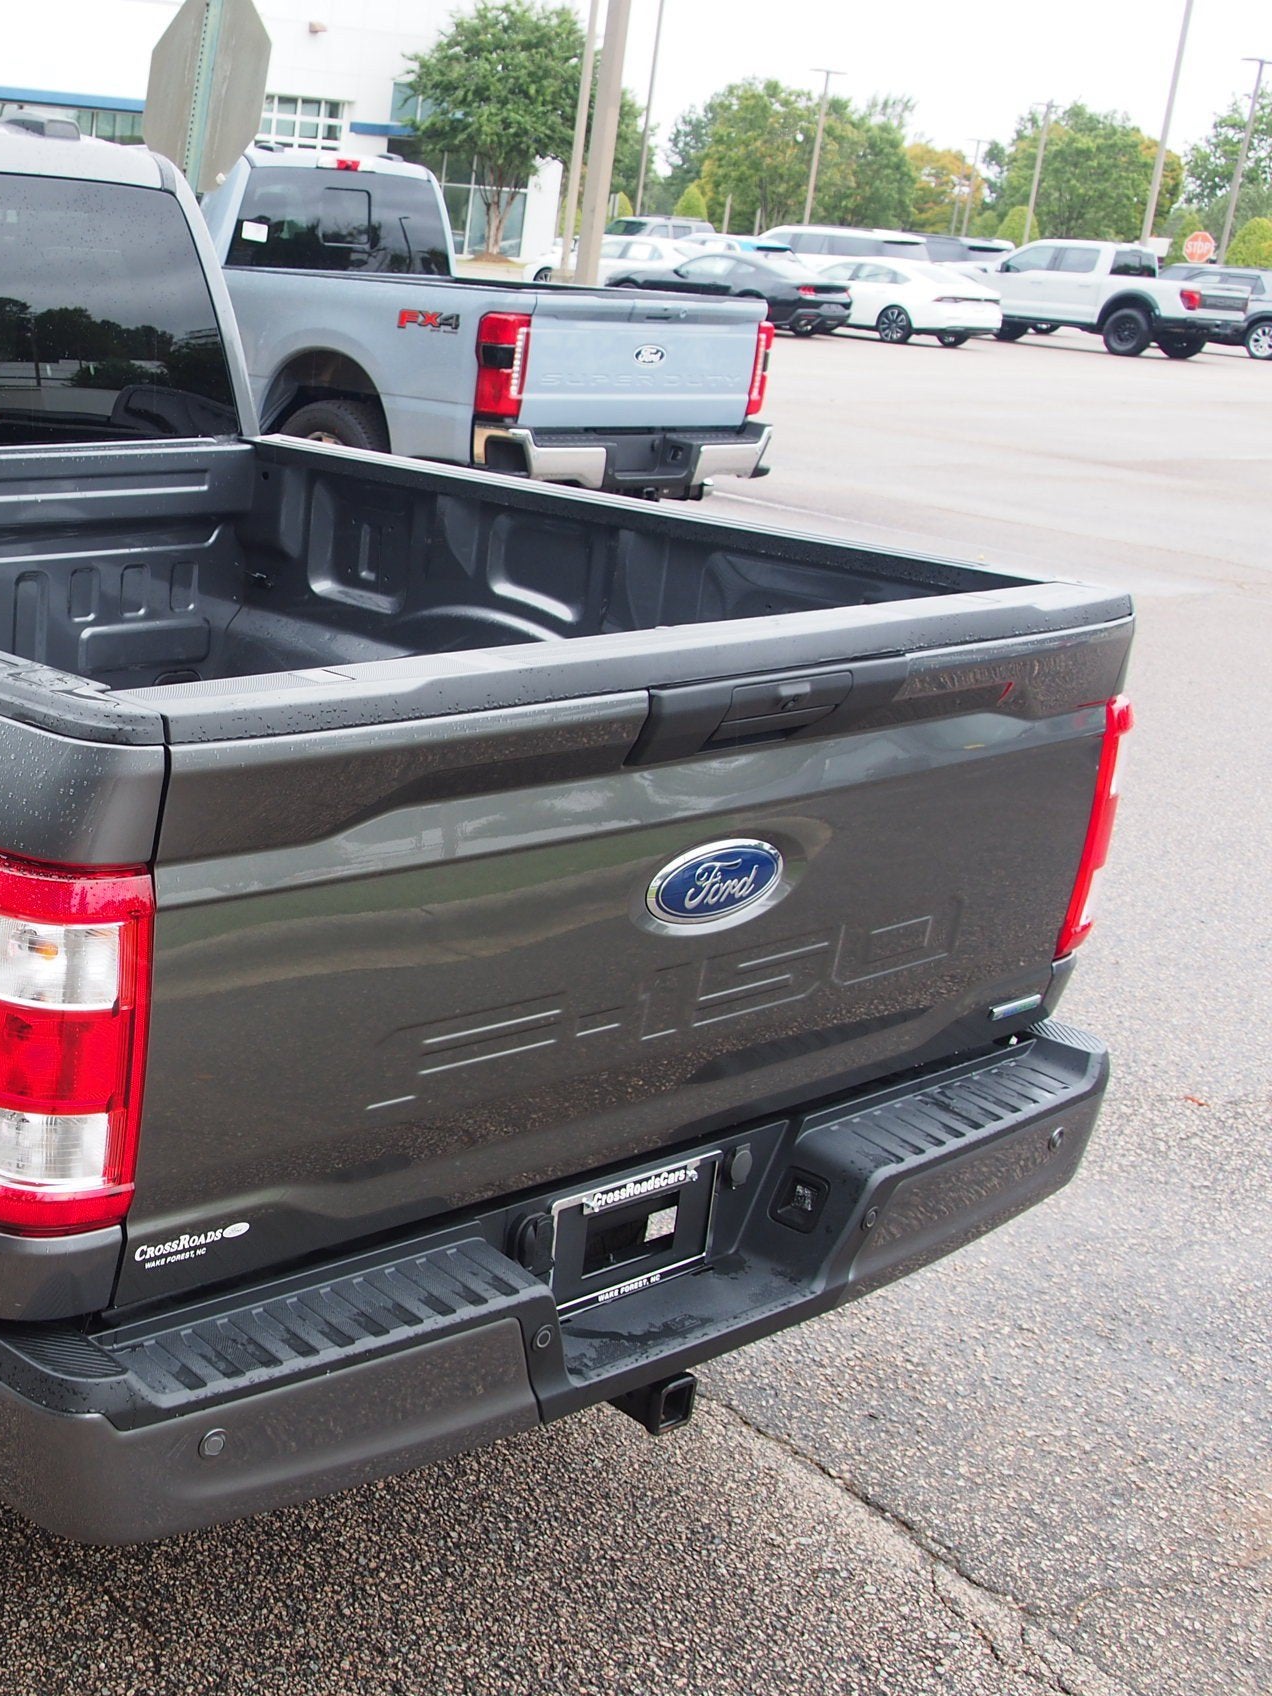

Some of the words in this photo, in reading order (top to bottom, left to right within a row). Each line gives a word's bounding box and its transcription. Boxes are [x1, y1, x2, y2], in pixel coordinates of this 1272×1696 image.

[1186, 239, 1214, 254] STOP
[397, 309, 460, 329] FX4
[540, 374, 654, 387] SUPER
[685, 858, 759, 909] Ford
[145, 1258, 166, 1269] WAKE
[166, 1251, 194, 1264] FOREST,
[196, 1247, 206, 1256] NC
[598, 1289, 620, 1303] WAKE
[620, 1278, 649, 1296] FOREST,
[650, 1274, 661, 1284] NC
